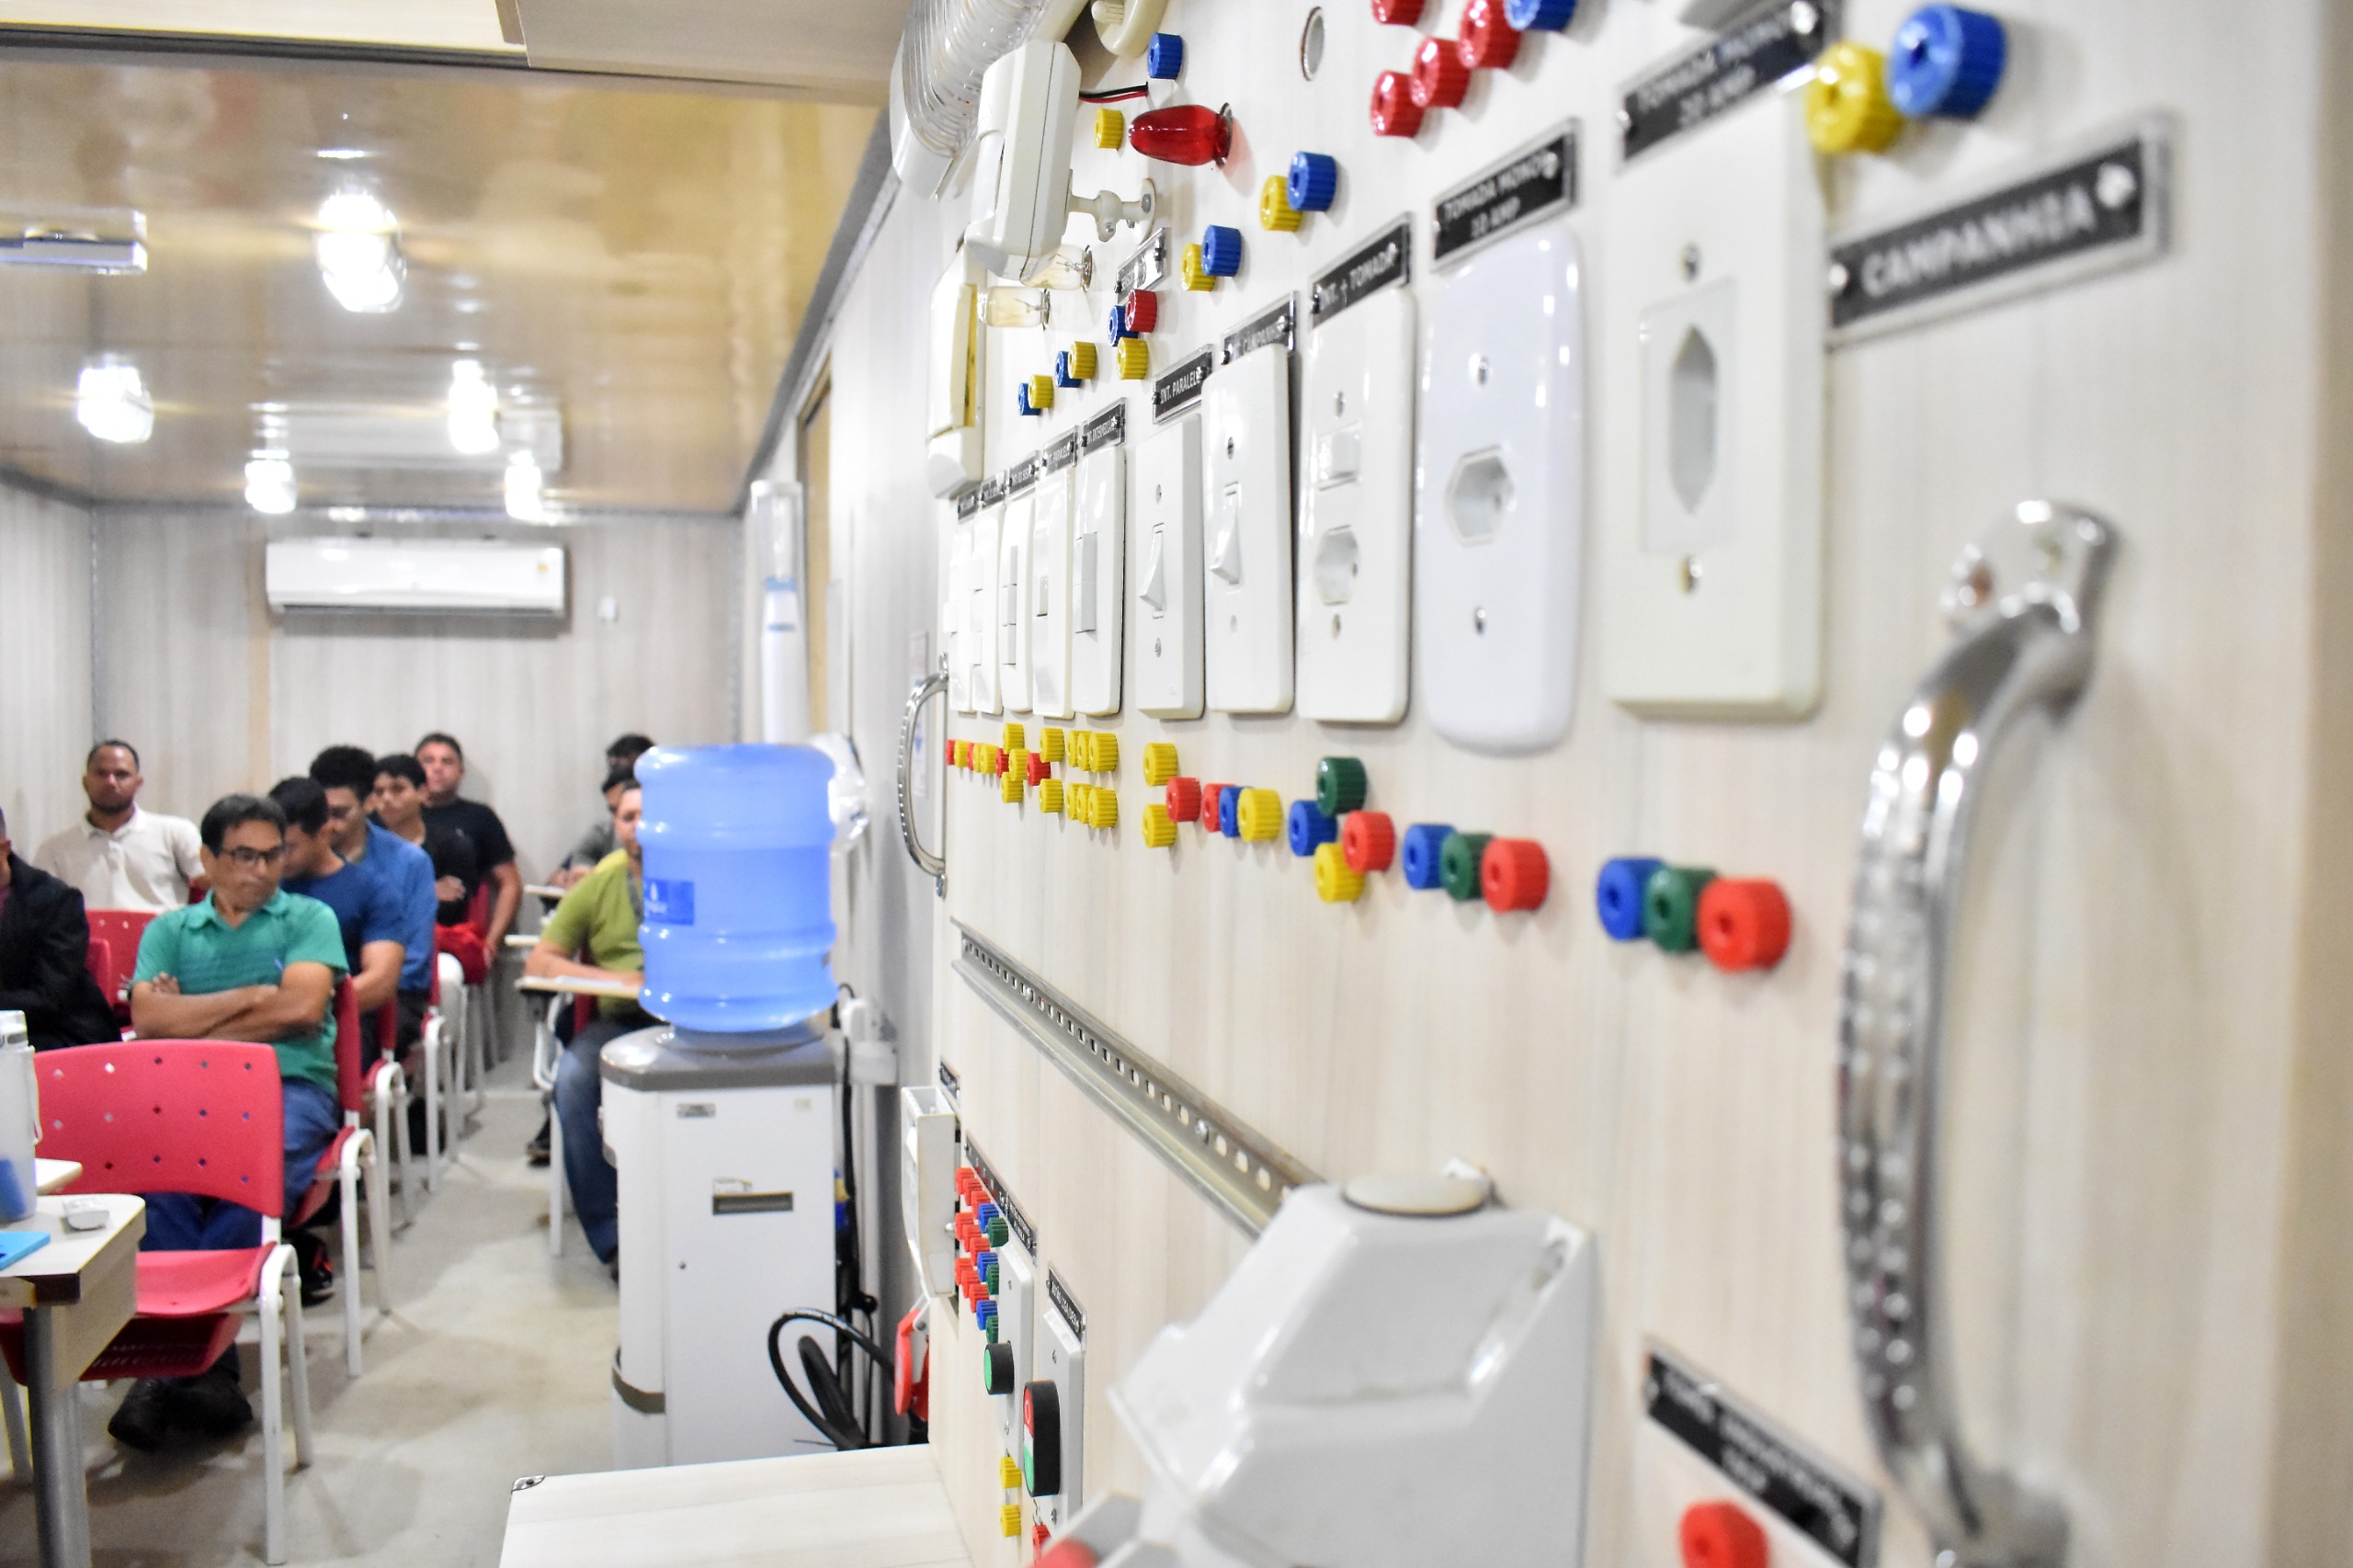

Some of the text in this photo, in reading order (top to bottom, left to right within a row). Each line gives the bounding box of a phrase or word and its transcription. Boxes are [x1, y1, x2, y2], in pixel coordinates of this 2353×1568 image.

[1443, 177, 1497, 222] TOMADA
[1860, 185, 2099, 299] CAMPANHIA
[1160, 384, 1172, 404] INT.
